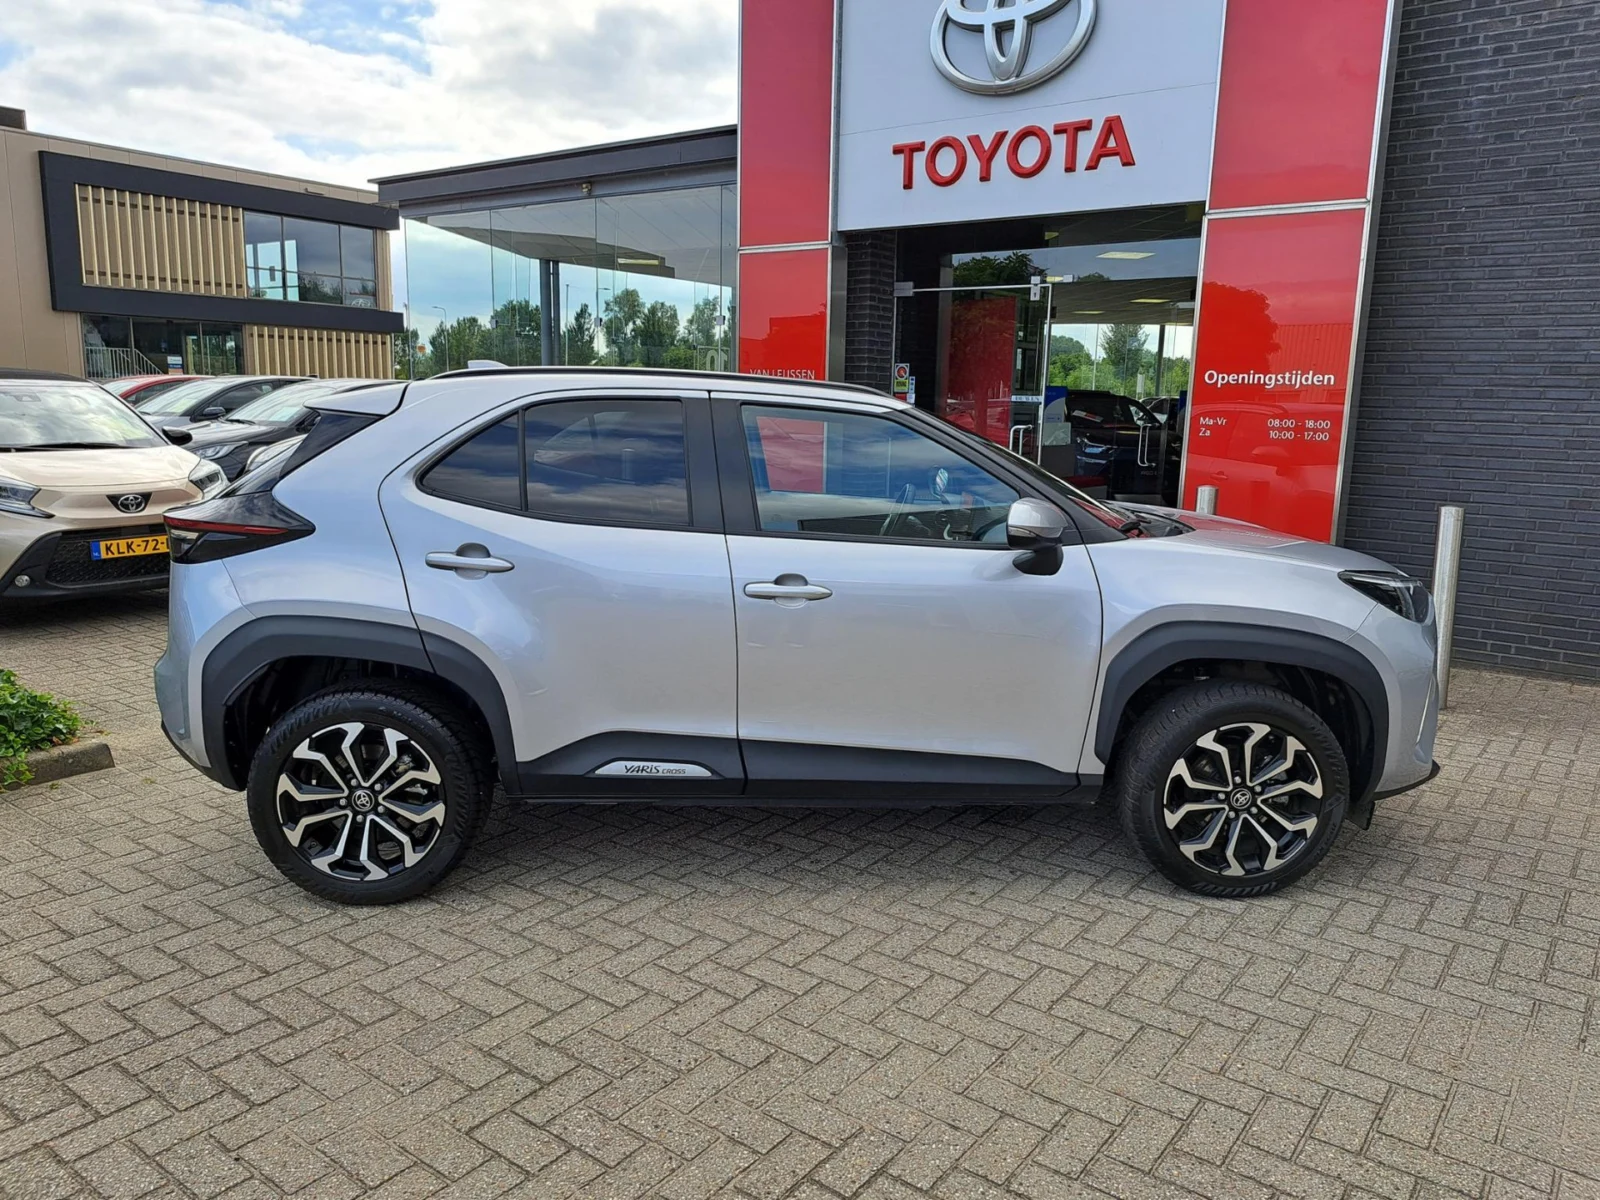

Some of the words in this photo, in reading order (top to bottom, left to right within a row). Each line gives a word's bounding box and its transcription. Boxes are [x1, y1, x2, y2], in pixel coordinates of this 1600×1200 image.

[892, 115, 1136, 190] TOYOTA
[1204, 370, 1335, 389] Openingstijden
[1199, 416, 1227, 426] Ma-Vr
[1267, 418, 1296, 428] 08:00
[1304, 419, 1331, 429] 18:00
[1199, 427, 1211, 436] Za
[1268, 430, 1295, 440] 10:00
[1303, 431, 1330, 441] 17:00
[104, 538, 169, 556] KLK-72-
